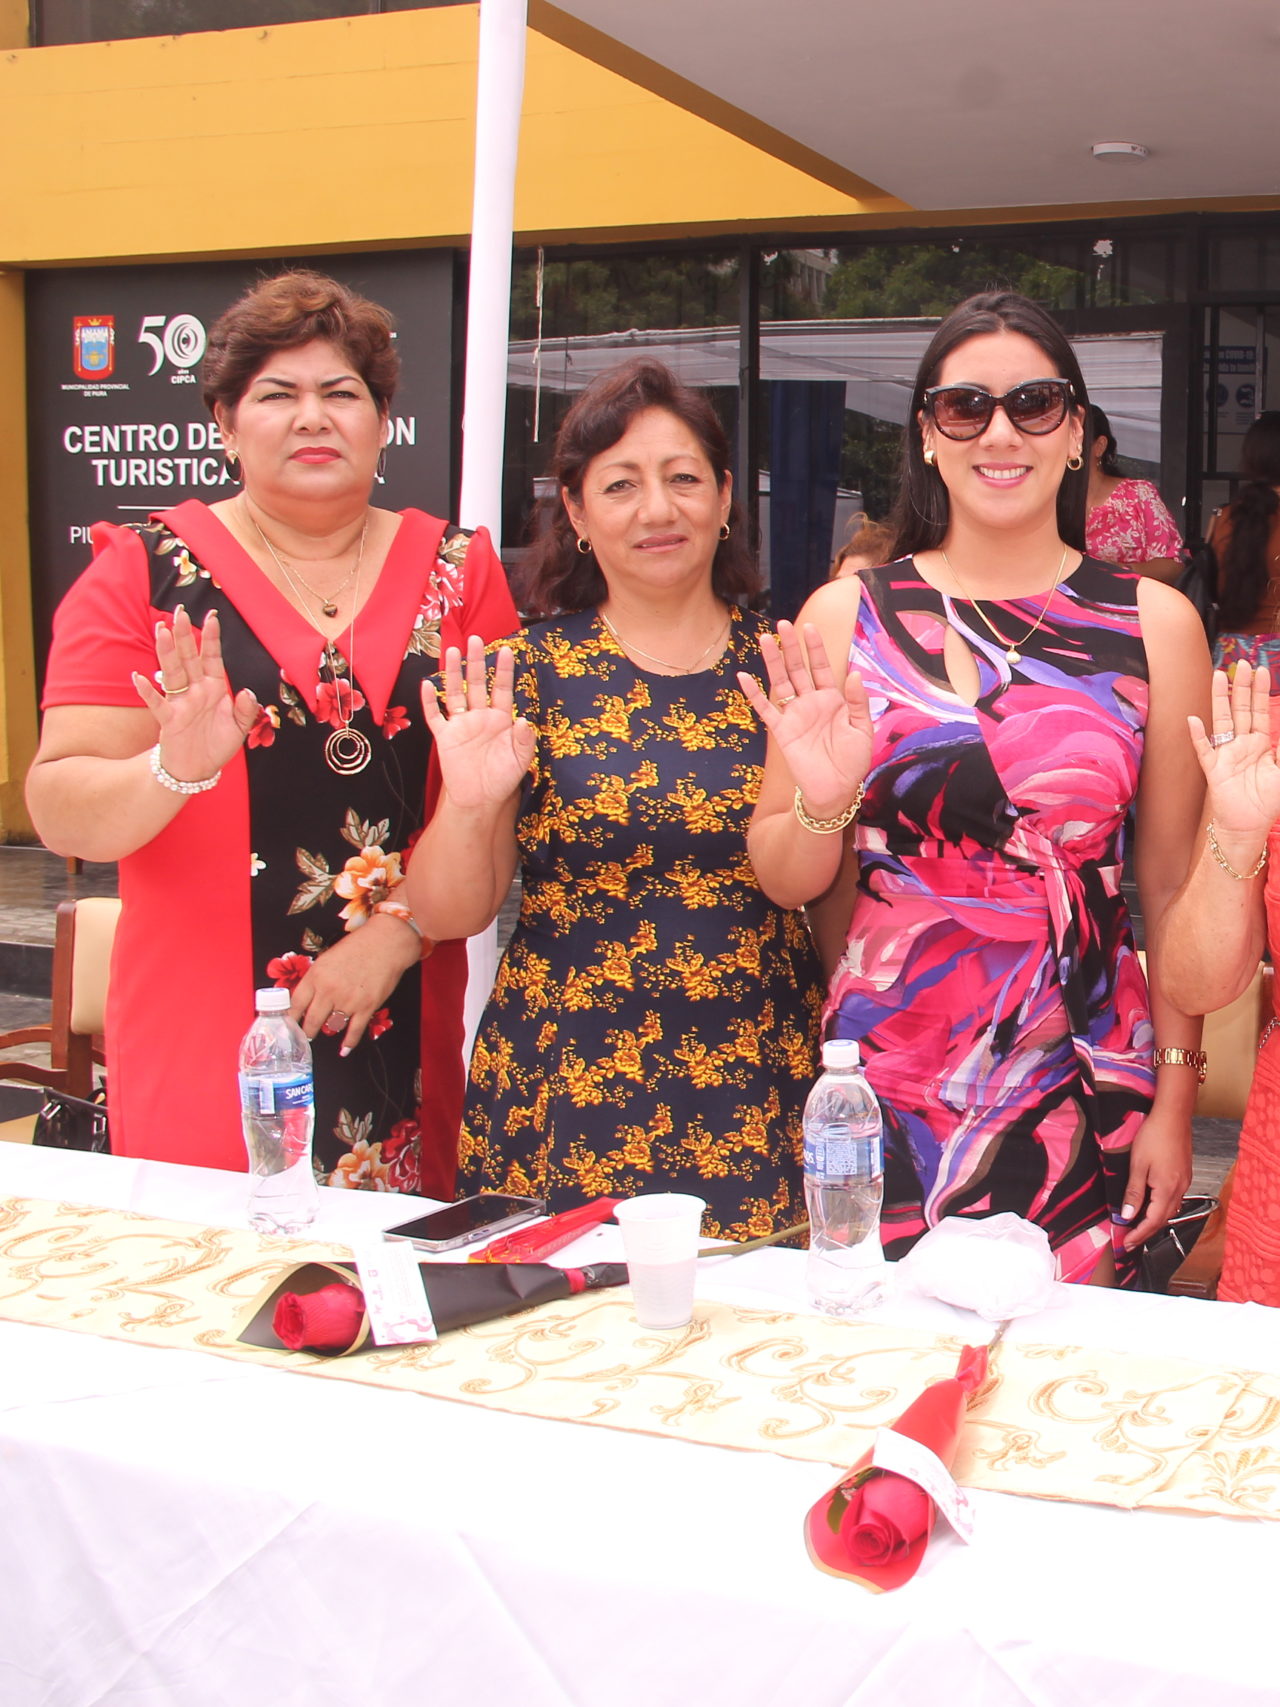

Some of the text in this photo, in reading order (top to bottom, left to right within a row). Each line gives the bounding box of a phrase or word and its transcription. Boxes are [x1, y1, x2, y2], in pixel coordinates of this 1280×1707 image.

[138, 314, 207, 376] 50
[171, 375, 197, 384] CIPCA
[64, 423, 180, 453] CENTRO
